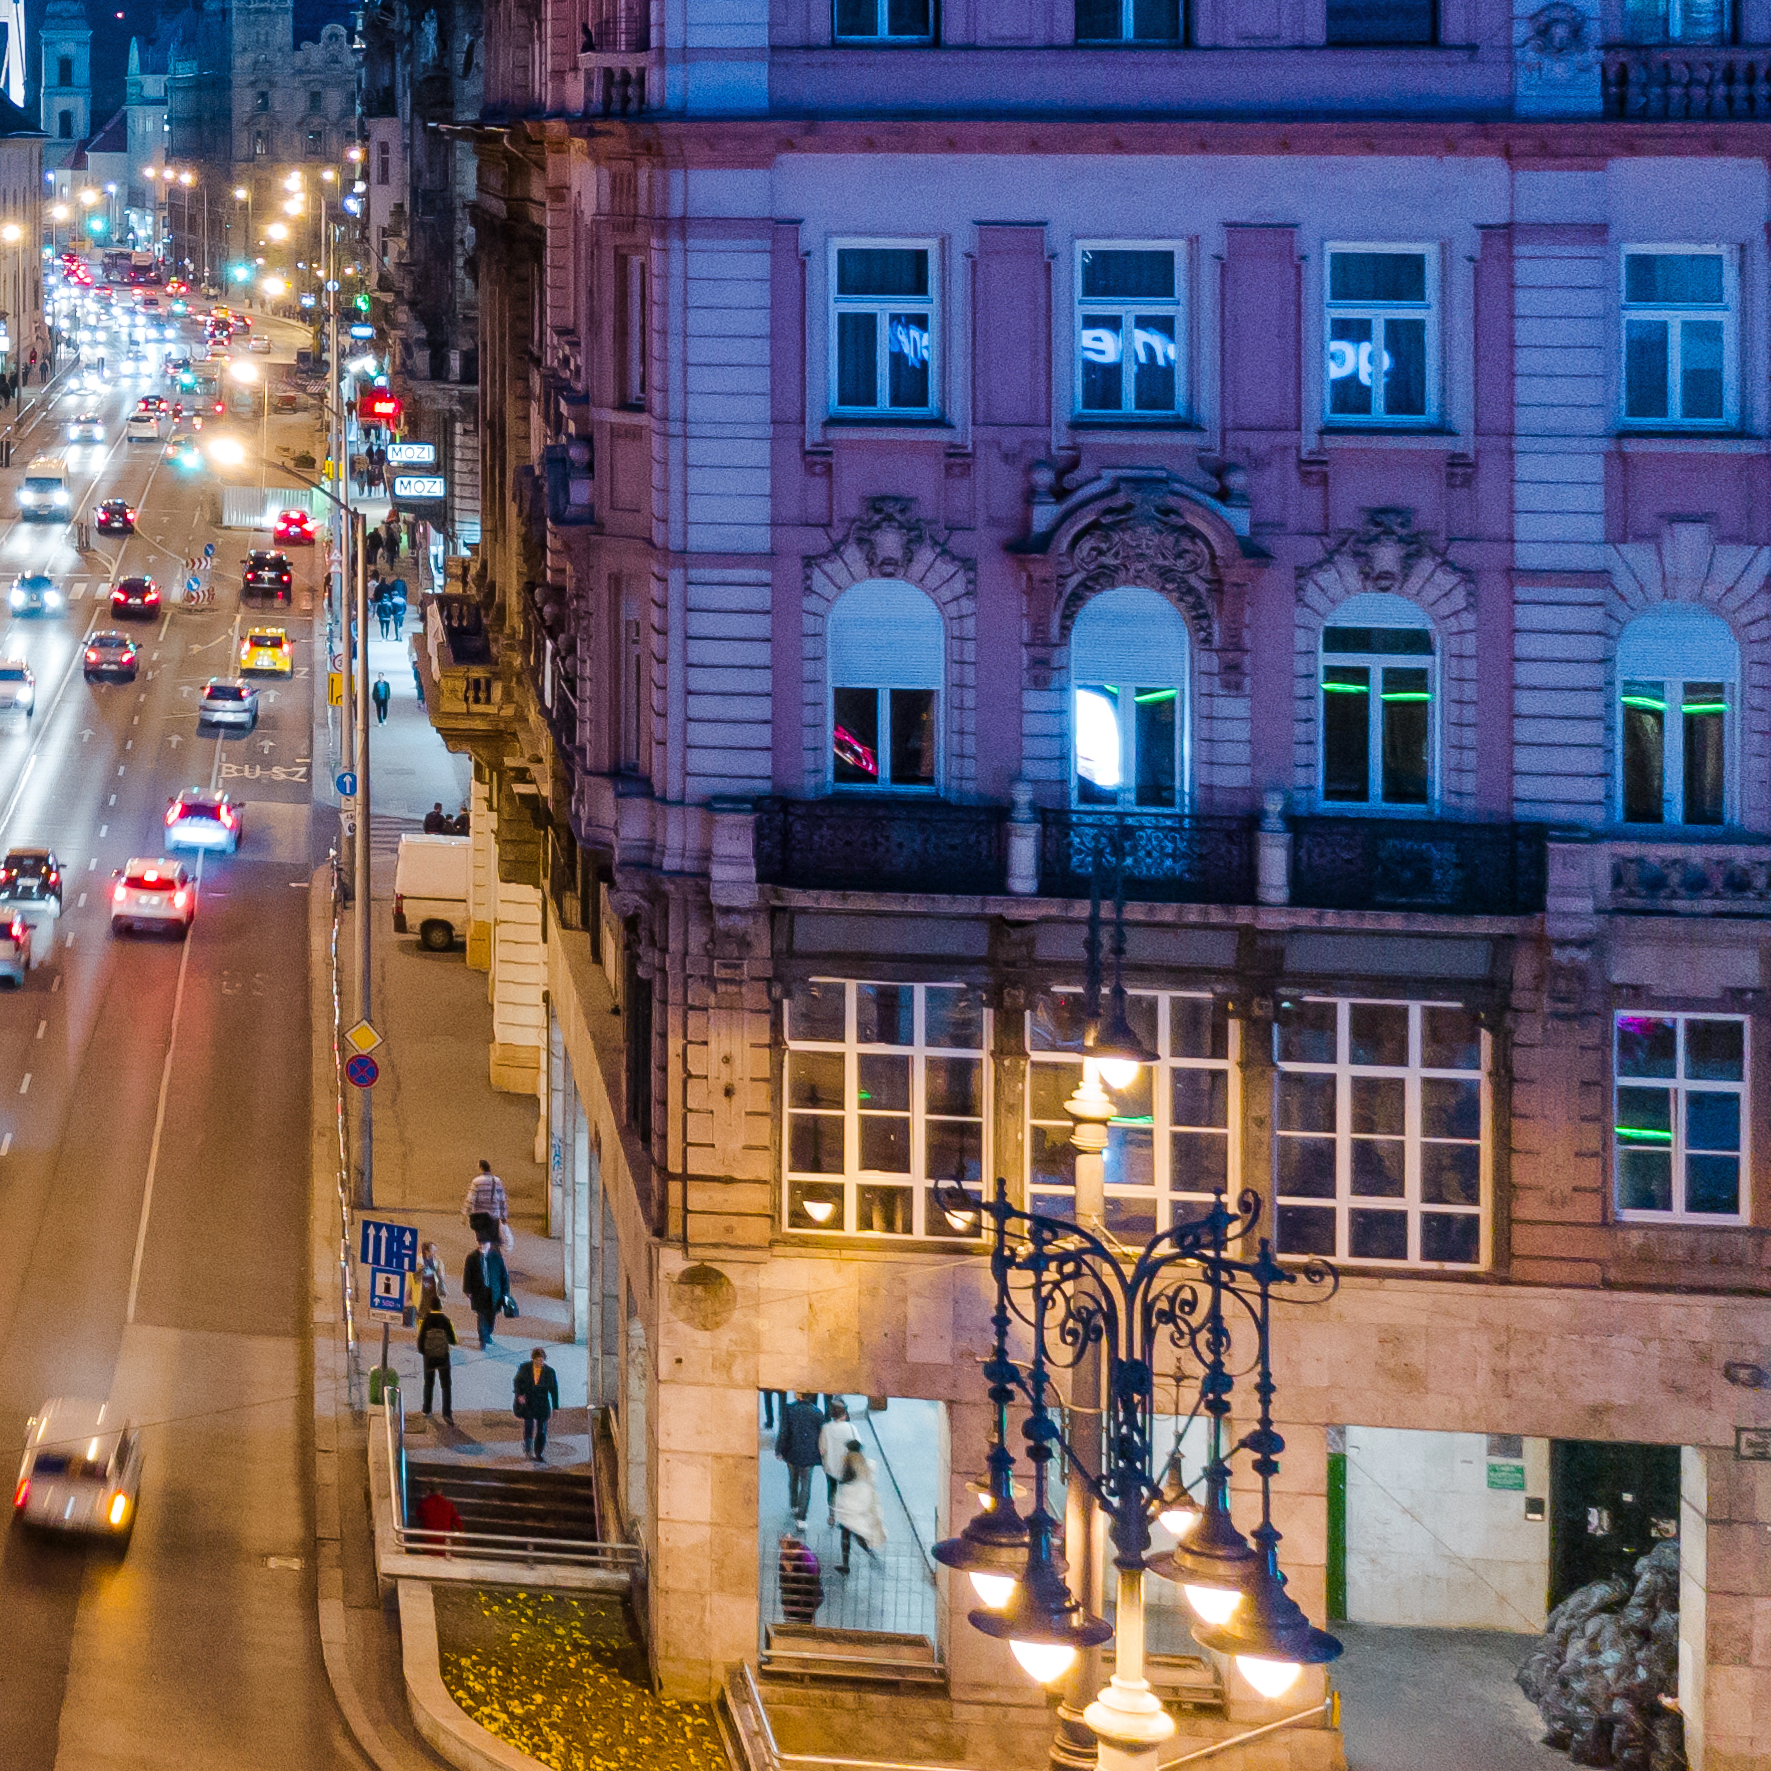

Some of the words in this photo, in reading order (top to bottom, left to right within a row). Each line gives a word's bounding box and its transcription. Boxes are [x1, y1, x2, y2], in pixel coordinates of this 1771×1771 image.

[391, 446, 432, 460] MOZI
[399, 480, 443, 494] MOZI
[220, 762, 307, 783] BUSZ
